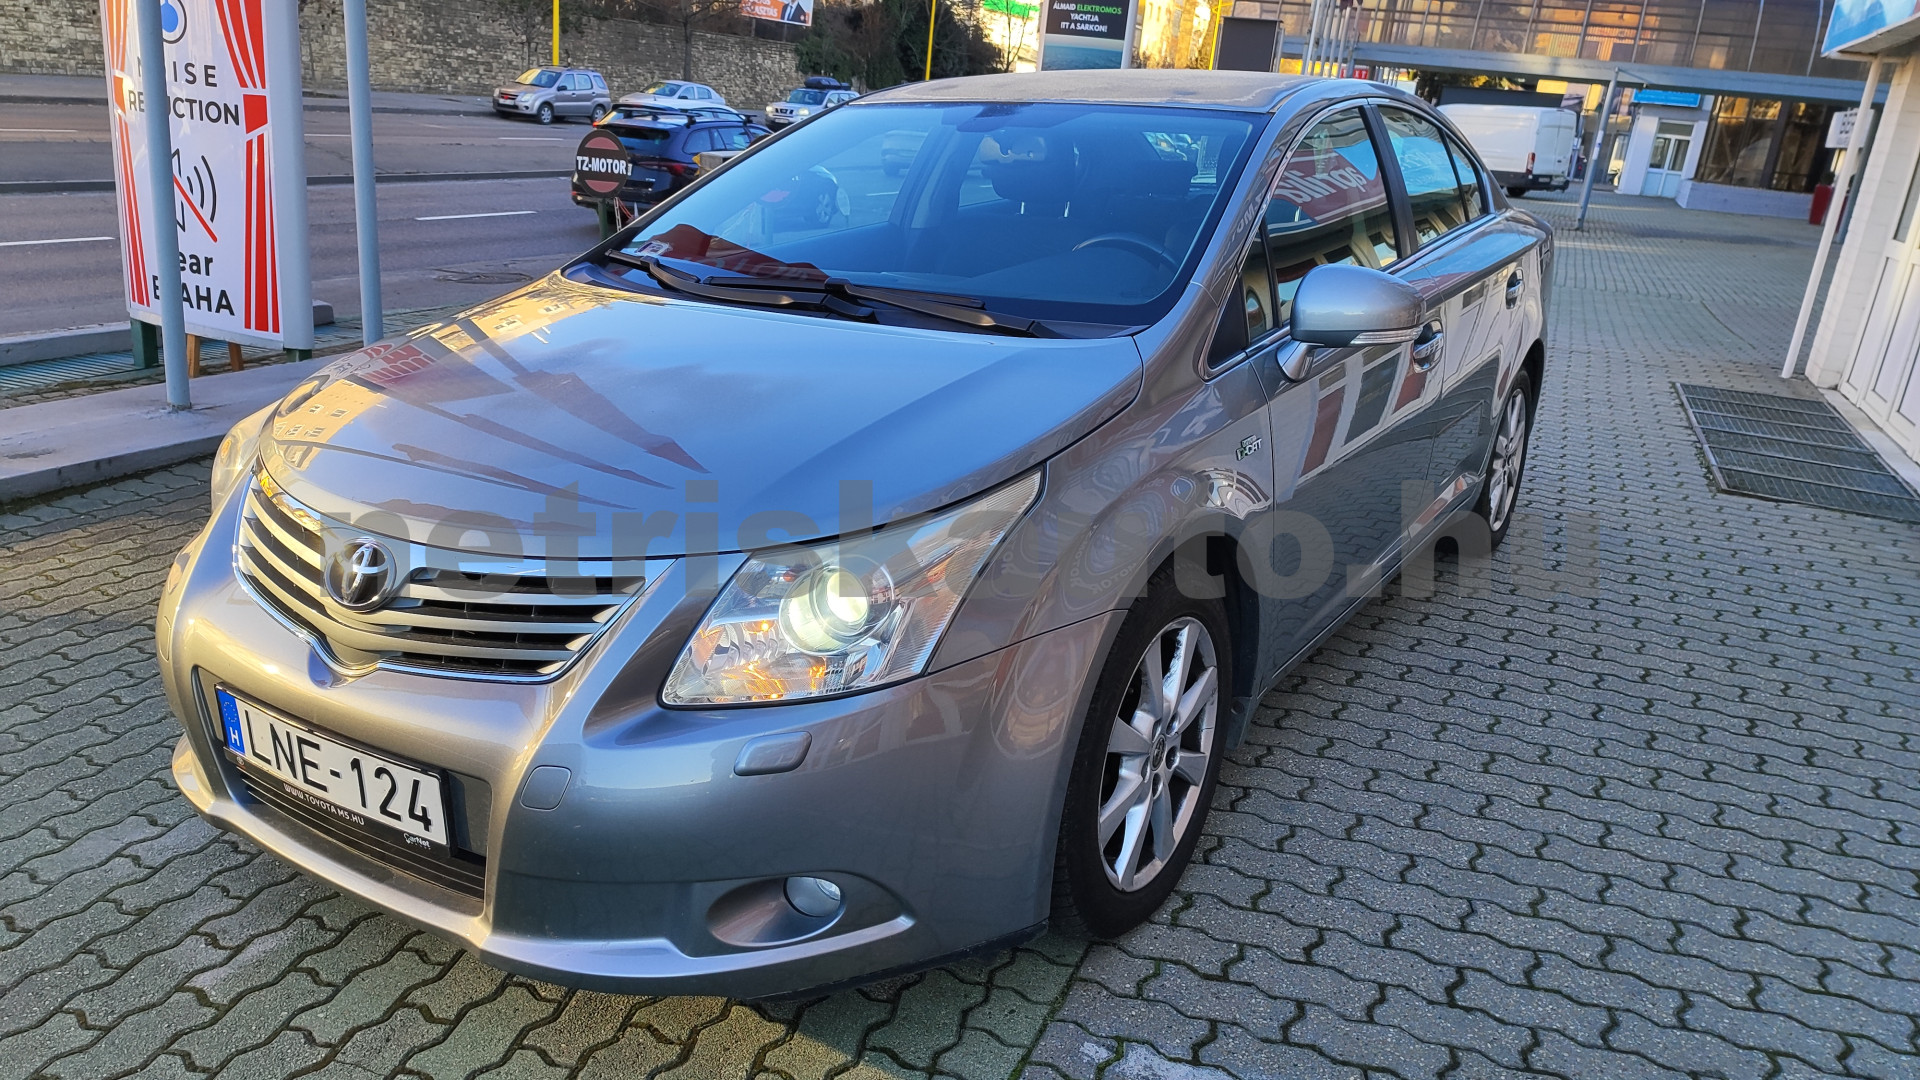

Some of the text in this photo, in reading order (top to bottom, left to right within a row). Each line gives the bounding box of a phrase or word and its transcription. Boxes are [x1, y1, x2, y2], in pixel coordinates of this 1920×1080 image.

[1070, 13, 1099, 22] YACHTJA
[1077, 3, 1122, 15] ELEKTROMOS
[137, 56, 217, 87] ISE
[128, 90, 240, 126] RECTION
[576, 155, 627, 175] TZ-MOTOR
[178, 251, 213, 276] ear
[229, 725, 241, 748] H
[244, 709, 432, 833] LNE-124
